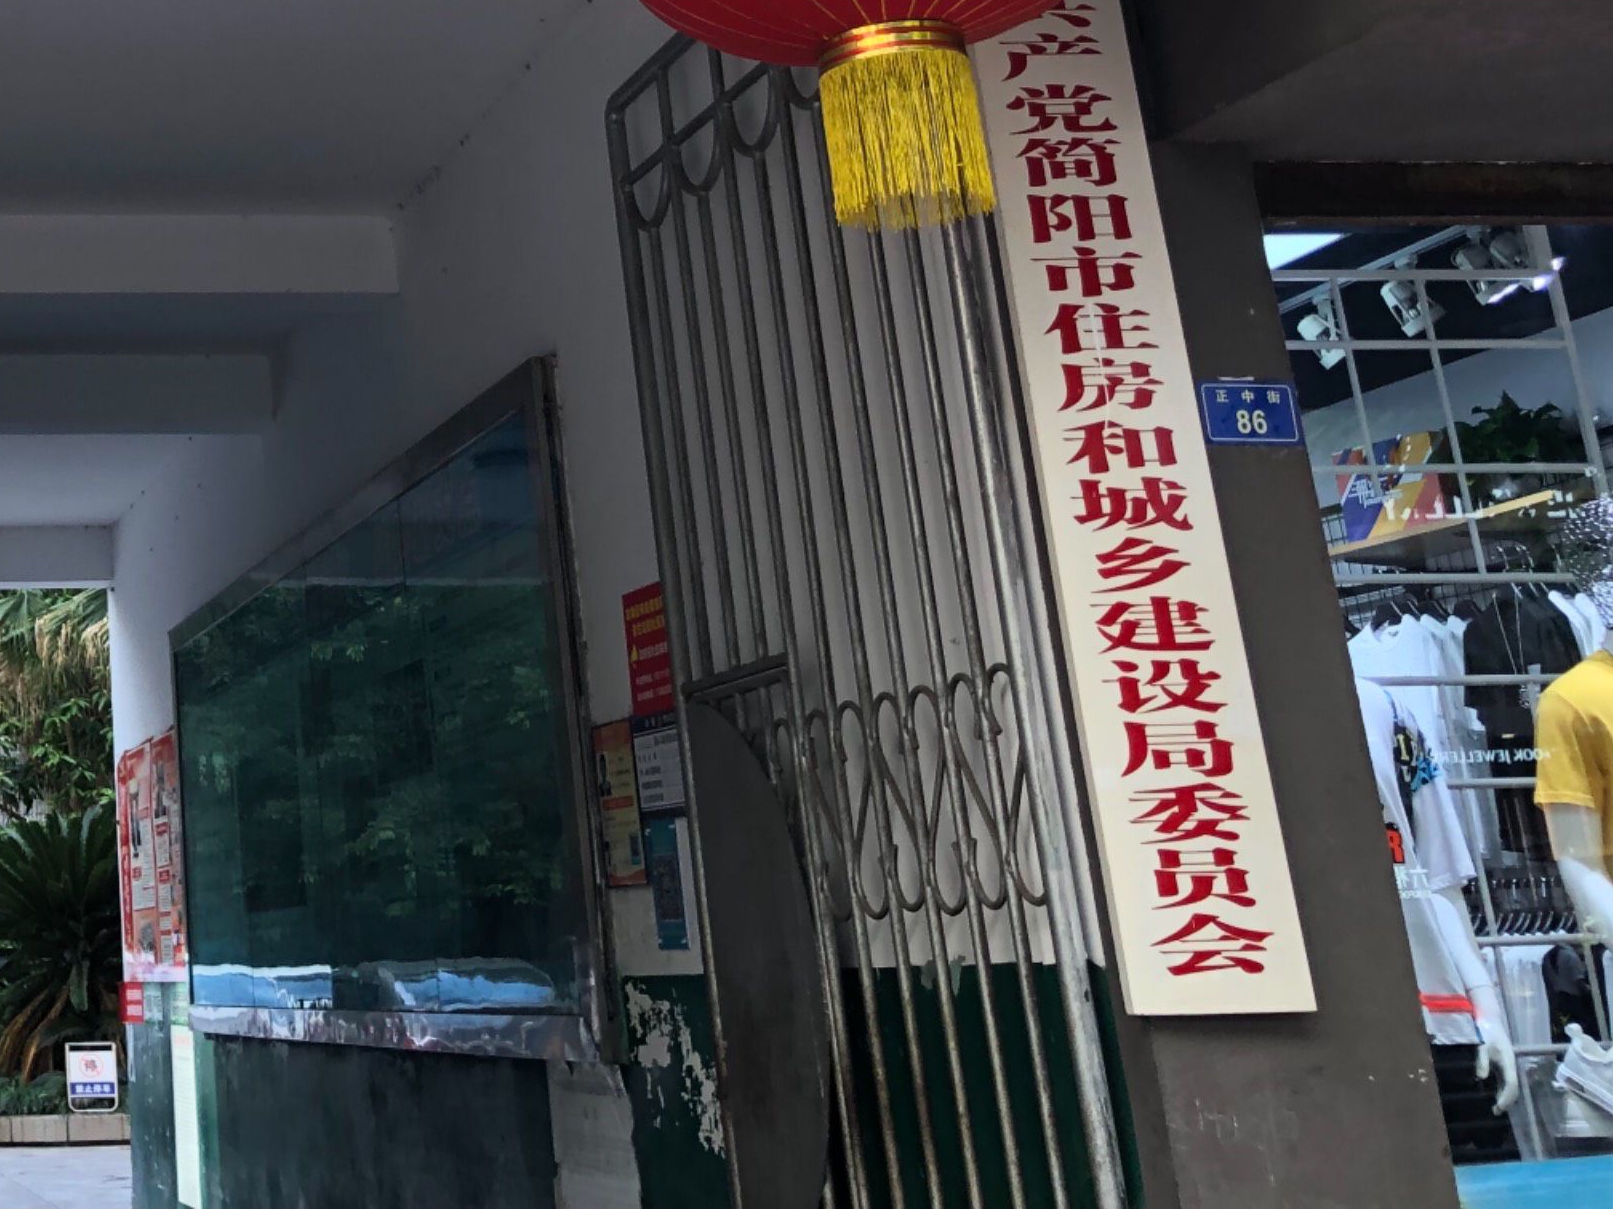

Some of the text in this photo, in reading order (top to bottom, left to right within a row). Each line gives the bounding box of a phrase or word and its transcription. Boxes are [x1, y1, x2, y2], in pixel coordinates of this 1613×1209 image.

[1215, 389, 1281, 405] 正中街
[1236, 410, 1268, 434] 86
